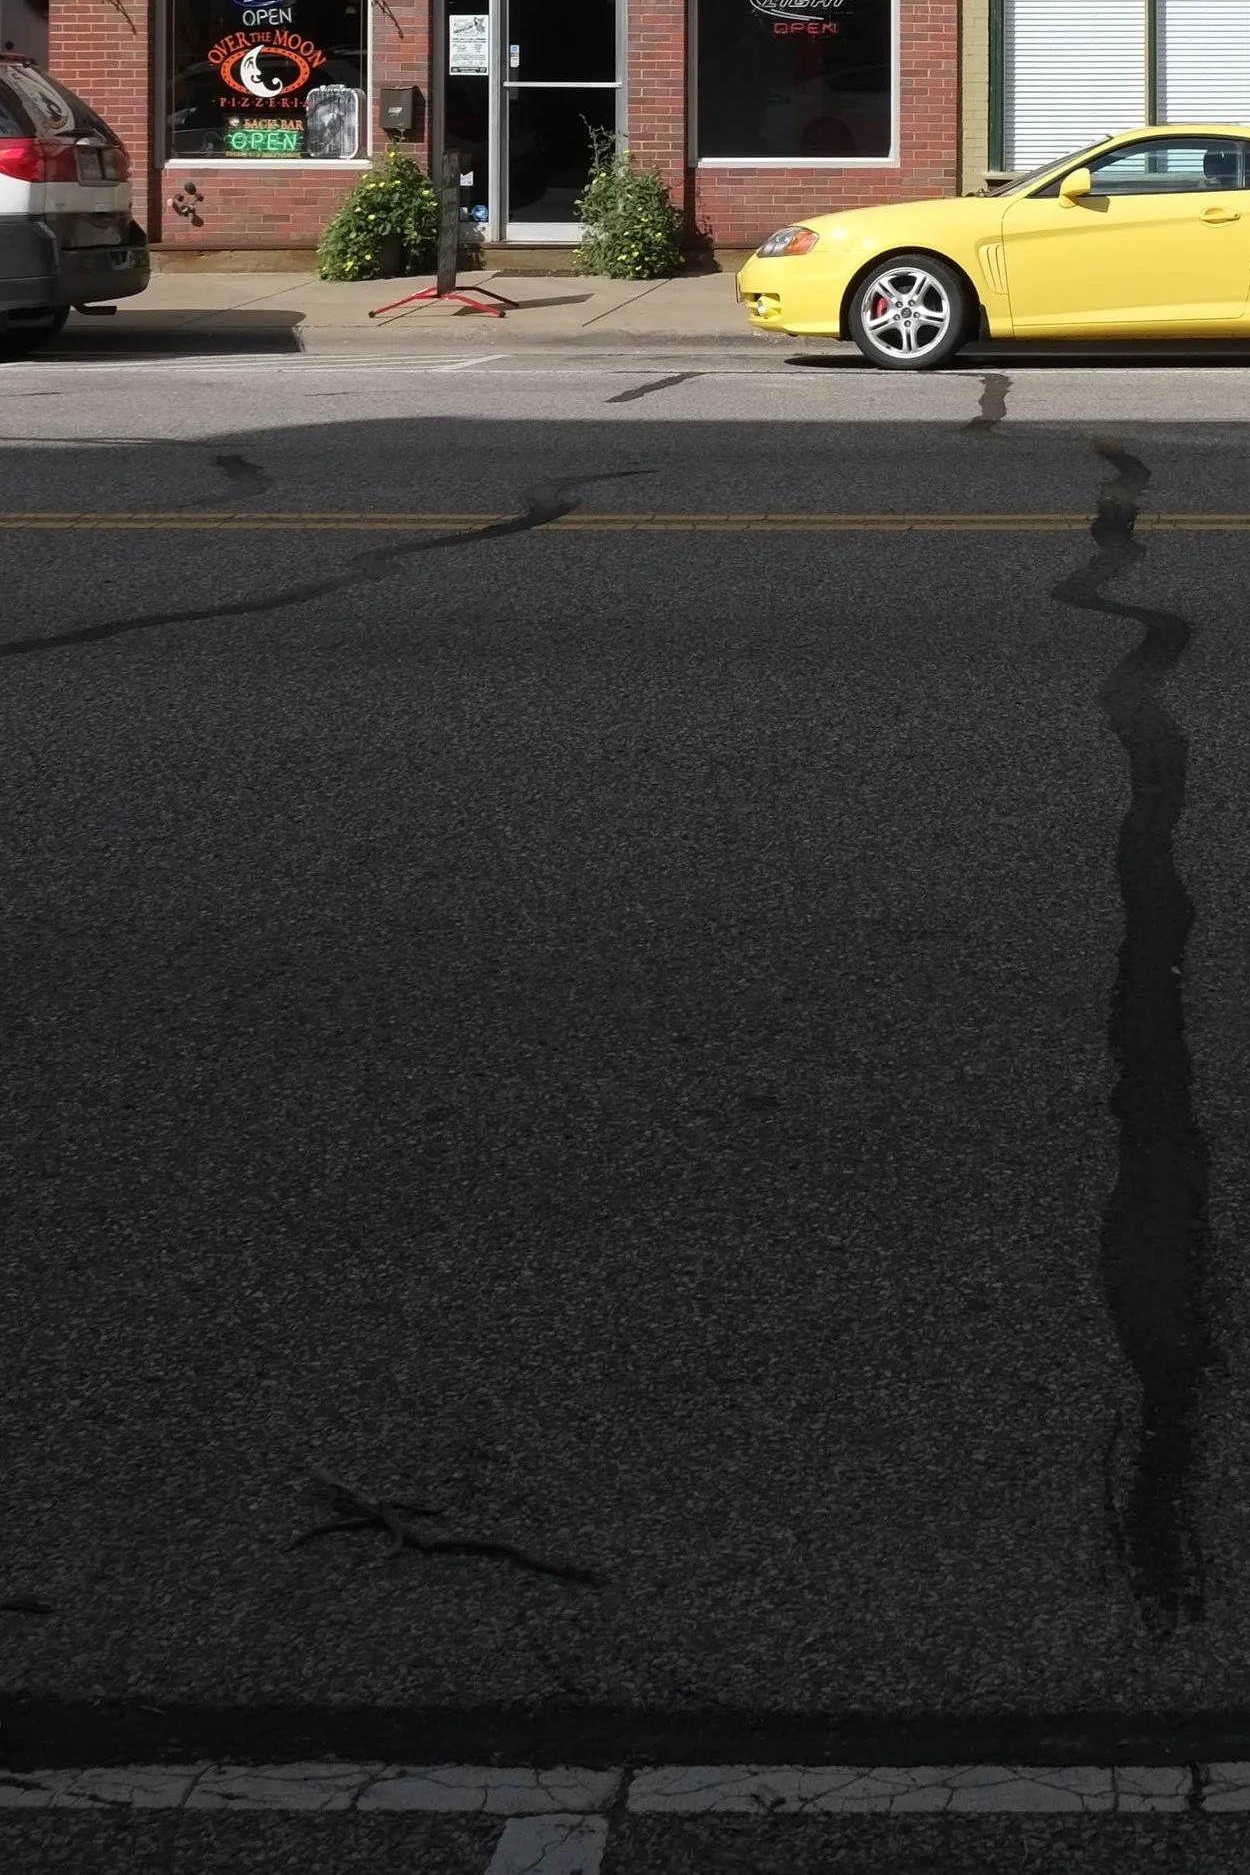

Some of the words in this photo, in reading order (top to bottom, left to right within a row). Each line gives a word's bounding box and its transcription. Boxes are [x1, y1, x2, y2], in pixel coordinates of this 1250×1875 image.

[242, 7, 293, 27] OPEN
[773, 22, 837, 34] OPEN
[208, 31, 252, 64] OVER
[249, 31, 272, 43] THE
[272, 29, 327, 68] MOON
[280, 119, 304, 131] BAR
[231, 132, 297, 150] OPEN
